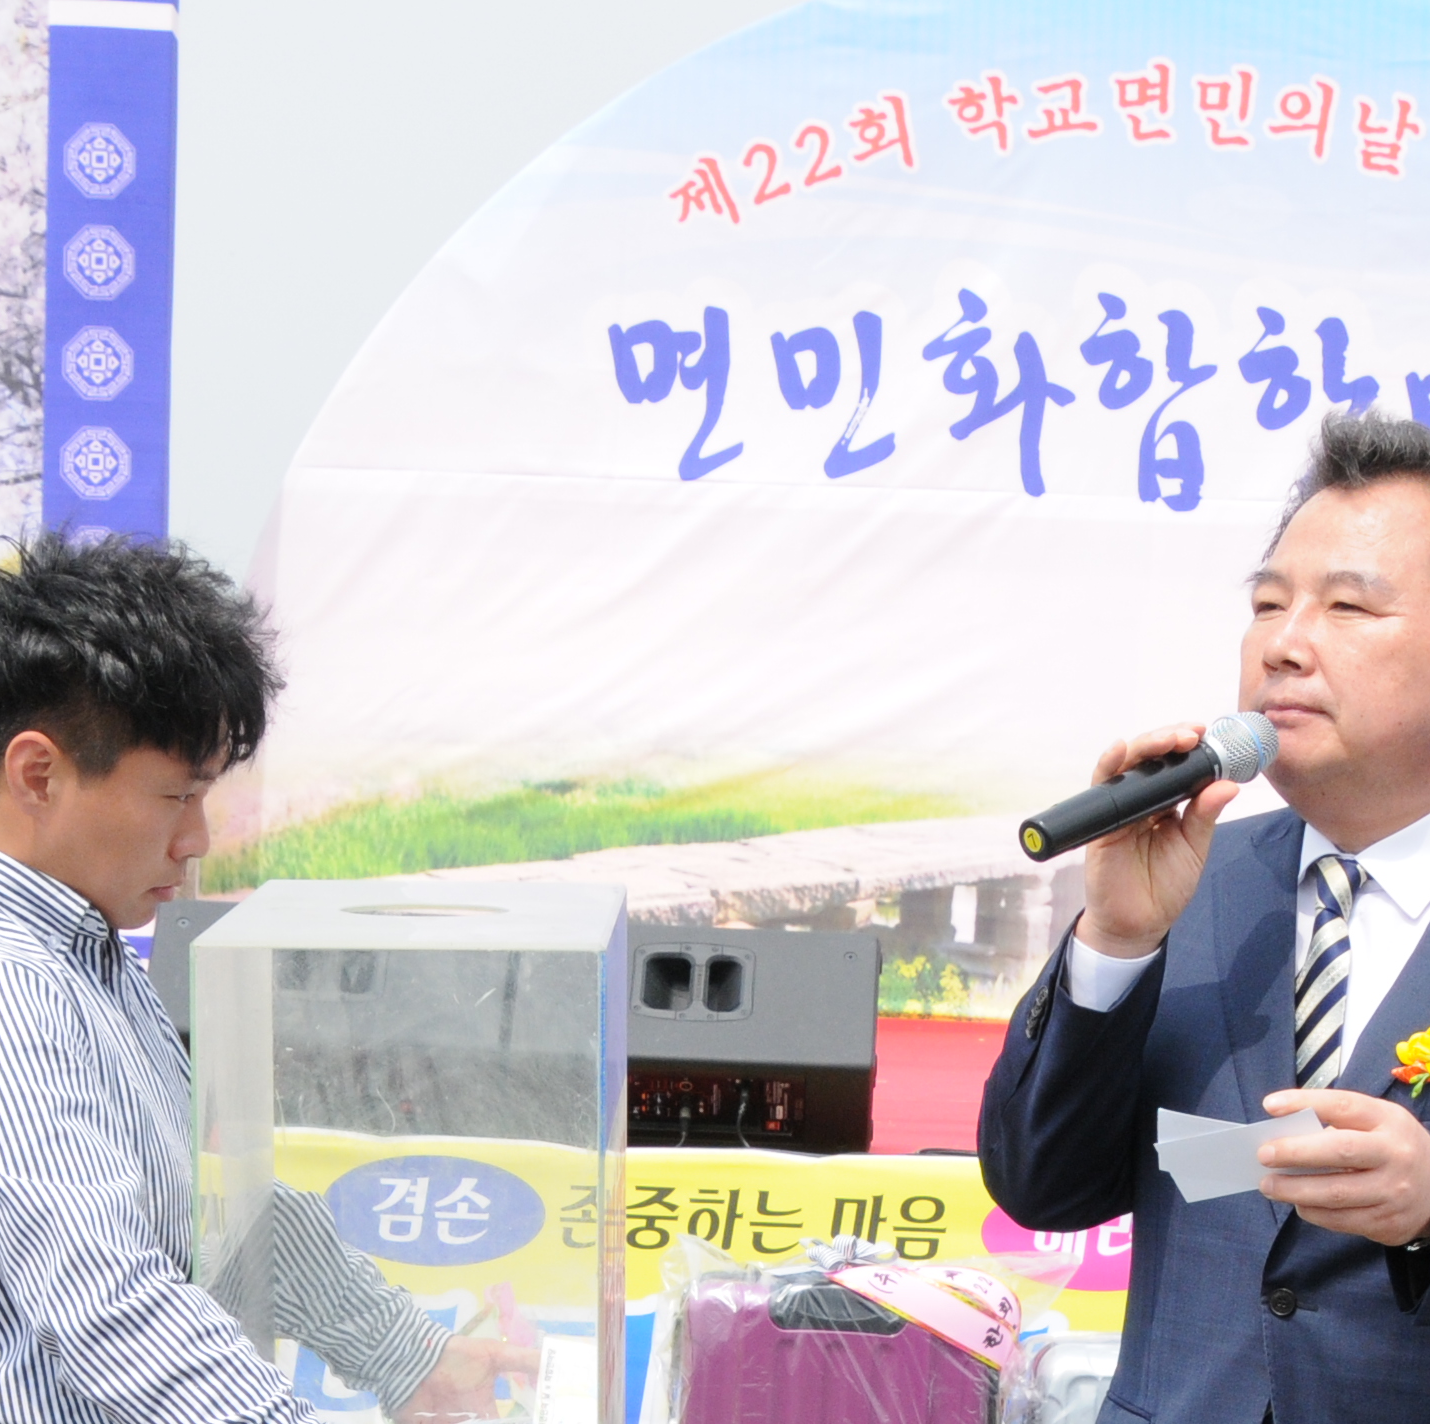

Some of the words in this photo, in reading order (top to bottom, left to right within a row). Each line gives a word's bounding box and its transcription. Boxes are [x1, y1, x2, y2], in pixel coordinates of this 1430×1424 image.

[668, 94, 917, 231] 제22회
[371, 1175, 492, 1246] 겸손
[559, 1184, 805, 1253] 존중하는
[831, 1193, 948, 1260] 마음
